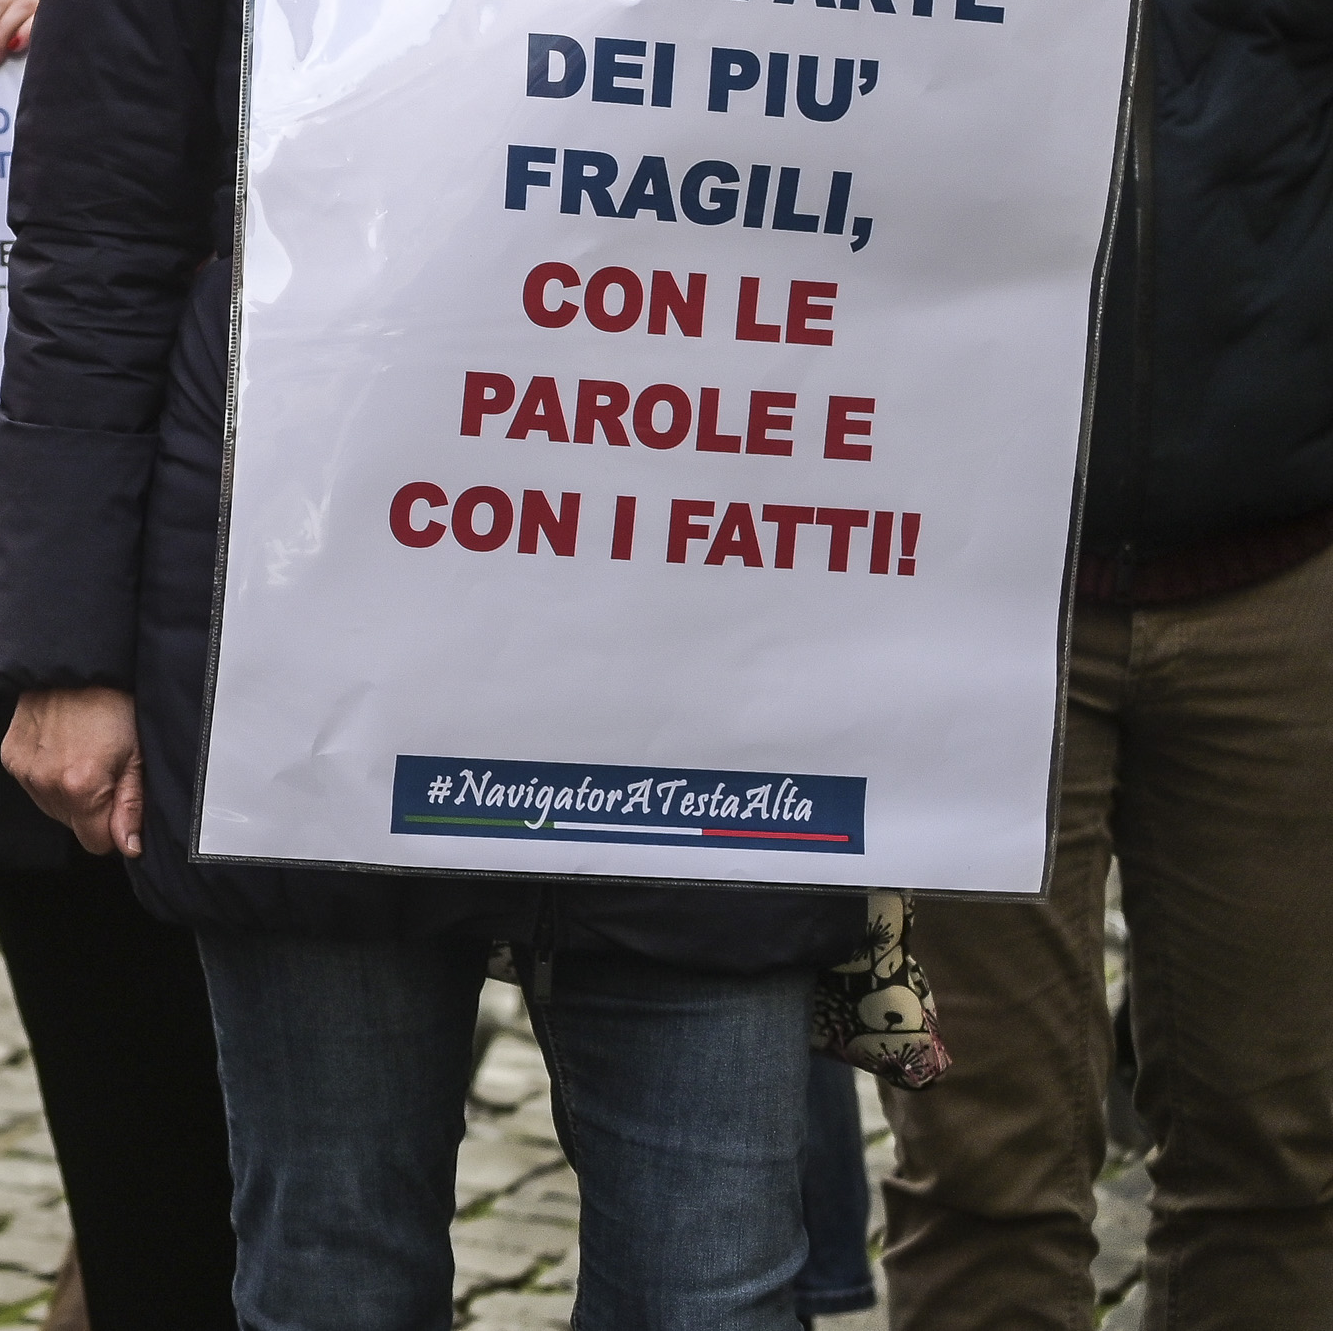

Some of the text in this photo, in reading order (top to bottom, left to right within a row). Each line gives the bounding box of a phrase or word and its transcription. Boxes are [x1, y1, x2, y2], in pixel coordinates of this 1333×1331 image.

[526, 32, 678, 108] DEI
[503, 144, 874, 255] FRAGILI,
[521, 261, 839, 347] CON LE
[458, 371, 876, 463] PAROLE E
[387, 481, 922, 577] CON I FATTI!
[426, 769, 815, 831] #NavigatorATestaAlta
